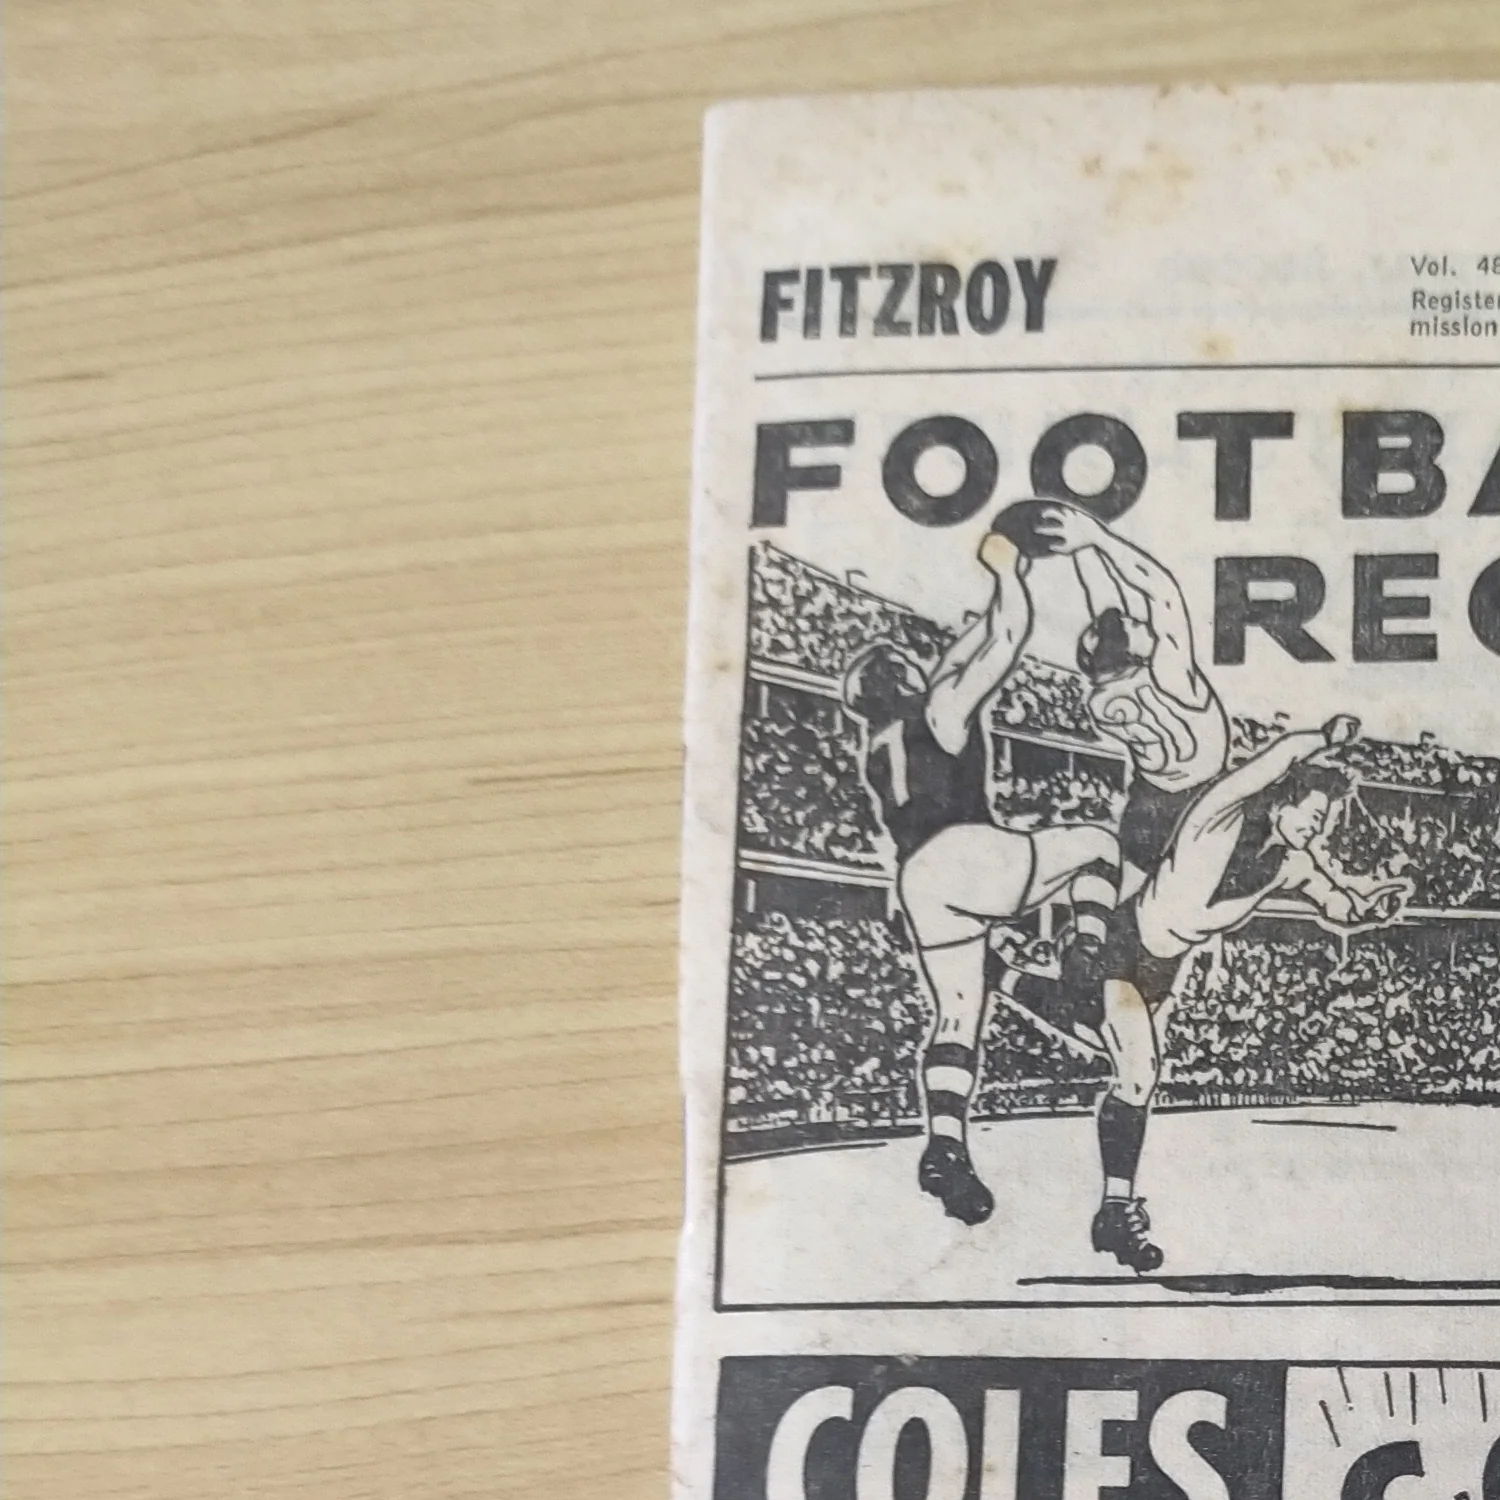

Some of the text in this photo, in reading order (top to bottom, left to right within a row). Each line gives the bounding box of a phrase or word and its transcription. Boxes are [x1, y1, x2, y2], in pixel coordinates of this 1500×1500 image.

[1410, 254, 1457, 277] Vol.
[759, 257, 1059, 343] FITZROY
[1409, 313, 1498, 337] mission
